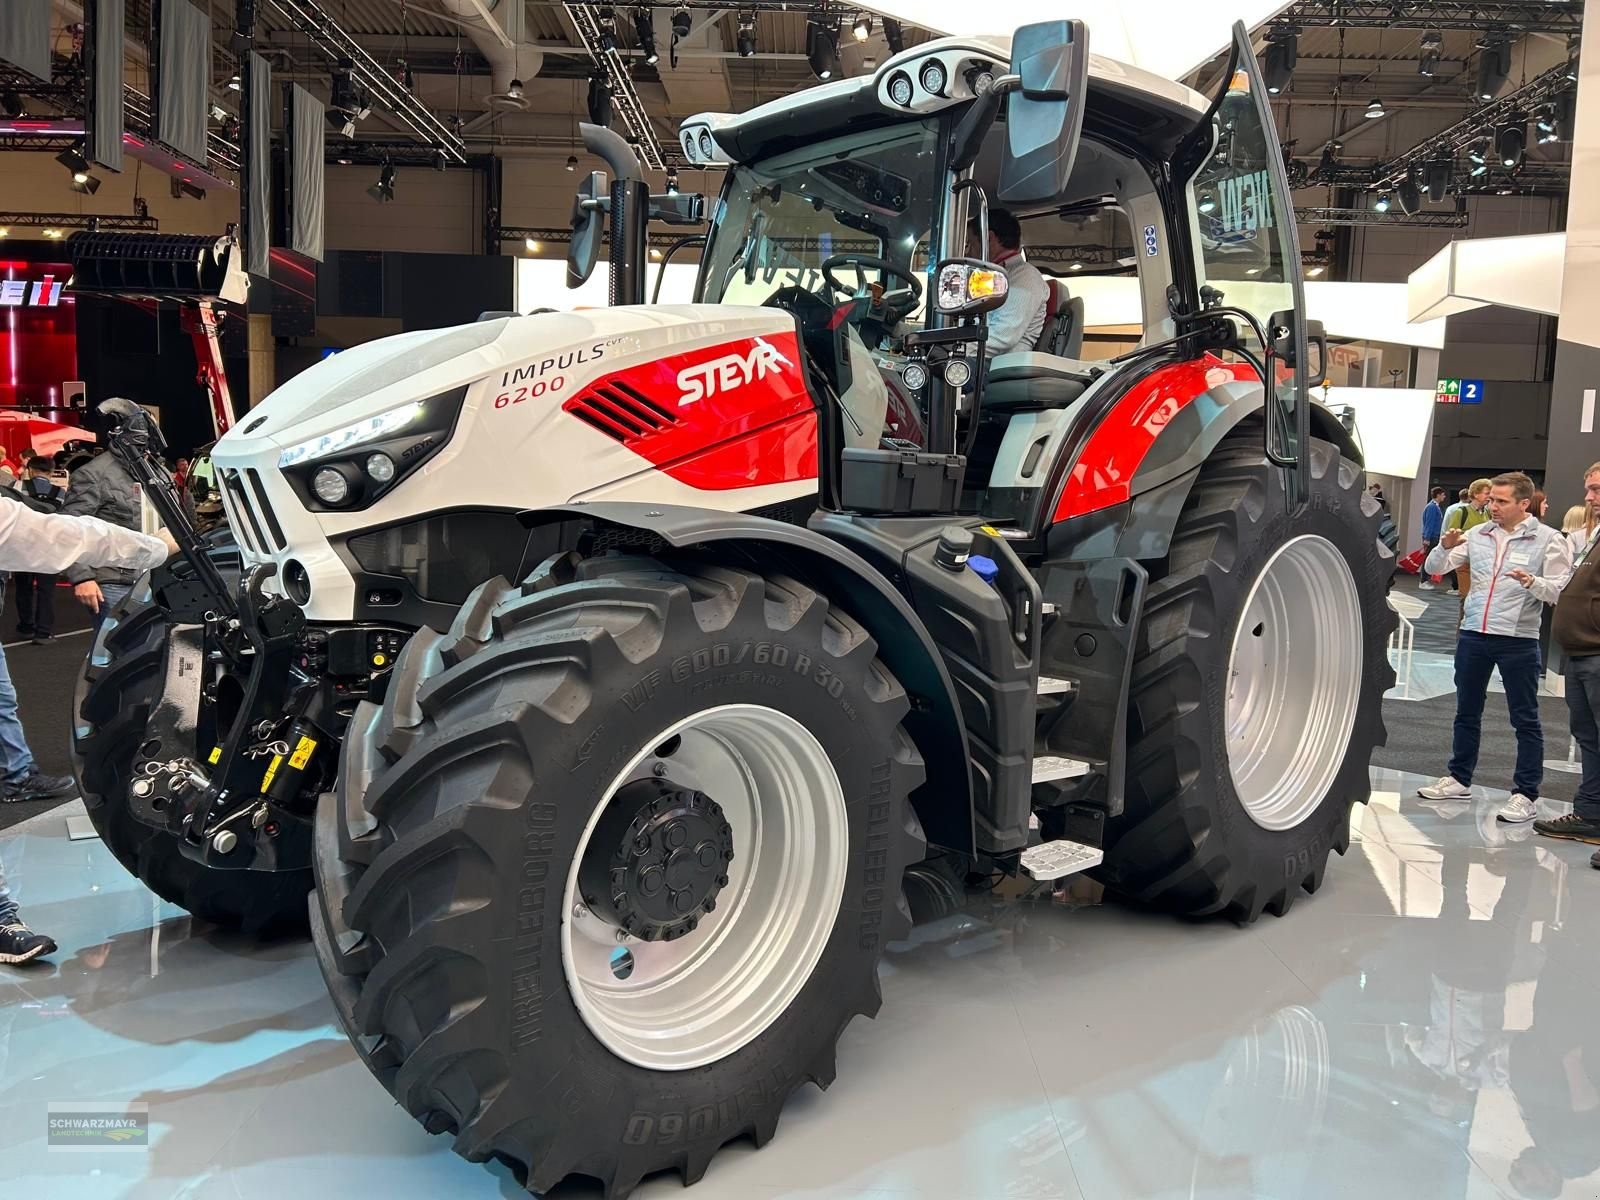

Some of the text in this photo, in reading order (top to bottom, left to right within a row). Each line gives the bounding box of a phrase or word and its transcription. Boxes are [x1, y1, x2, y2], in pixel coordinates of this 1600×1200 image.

[501, 342, 605, 387] IMPULS
[676, 337, 791, 407] STEYR
[494, 376, 566, 409] 6200
[1465, 383, 1477, 399] 2
[401, 436, 433, 459] STEYR
[670, 640, 789, 684] 600/60
[793, 651, 812, 676] R
[814, 663, 845, 699] 30
